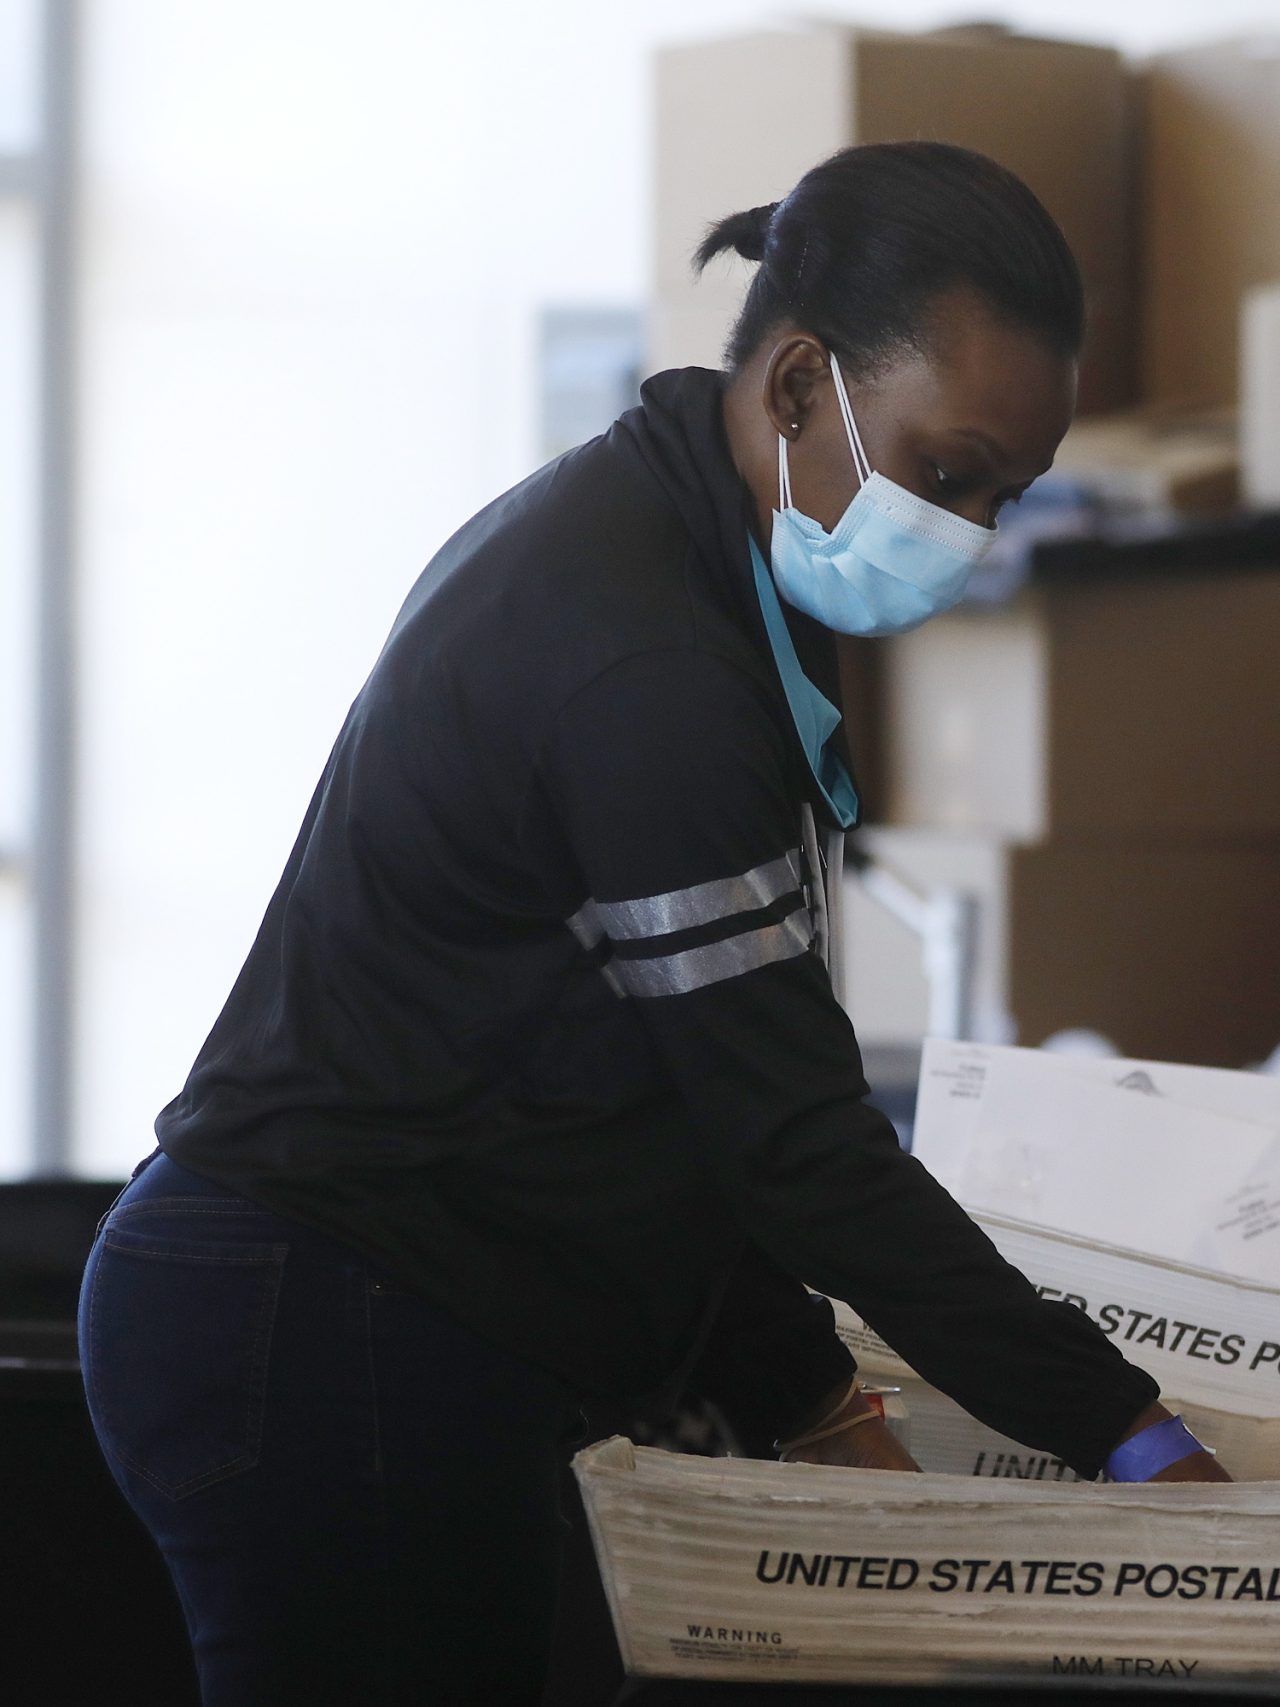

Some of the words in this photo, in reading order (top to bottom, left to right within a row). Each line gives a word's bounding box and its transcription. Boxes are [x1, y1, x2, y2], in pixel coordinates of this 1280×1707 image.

[1098, 1304, 1244, 1365] STATES
[973, 1451, 1081, 1483] UNIT
[756, 1550, 919, 1591] UNITED
[928, 1558, 1105, 1597] STATES
[687, 1624, 782, 1645] WARNING
[1053, 1655, 1104, 1676] MM
[1114, 1657, 1199, 1678] TRAY
